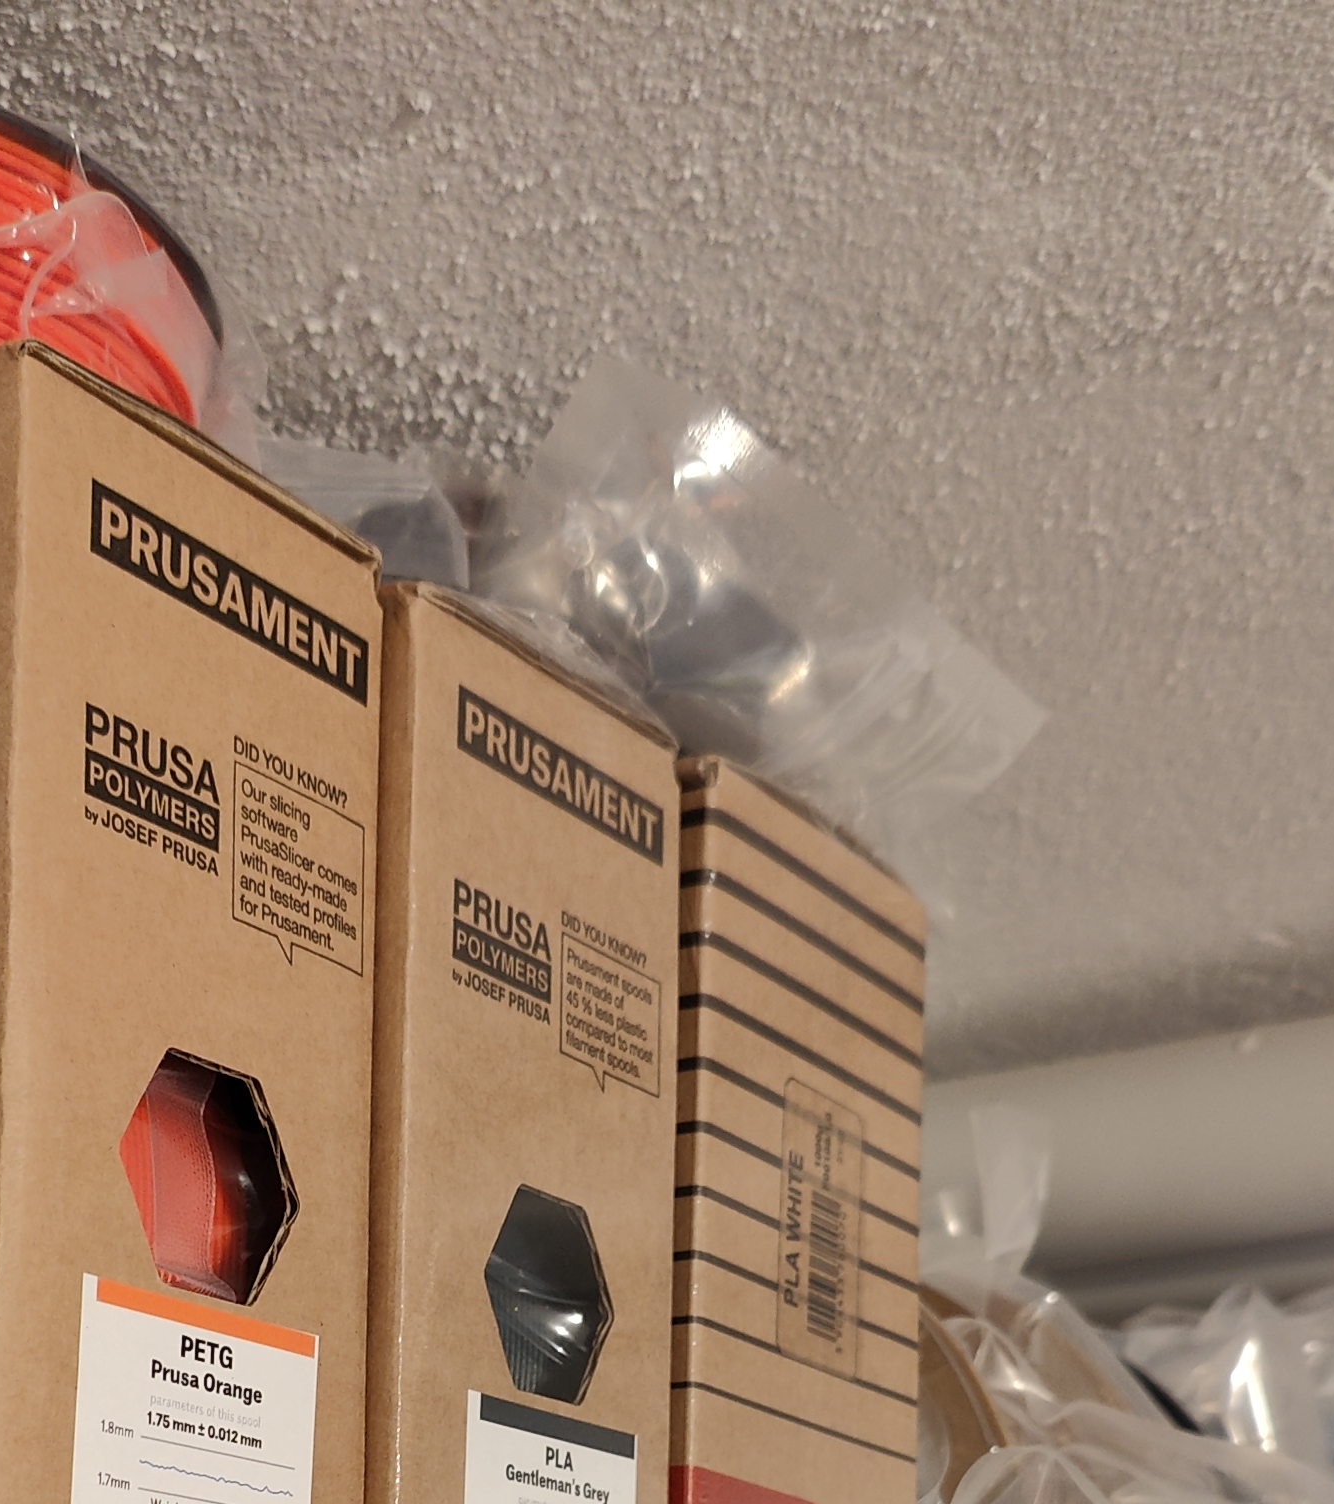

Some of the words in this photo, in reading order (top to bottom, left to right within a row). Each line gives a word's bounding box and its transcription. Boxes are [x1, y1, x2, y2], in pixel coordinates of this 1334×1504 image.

[101, 497, 362, 688] PRUSAMENT
[86, 702, 220, 805] PRUSA
[233, 734, 259, 763] DID
[262, 748, 293, 781] YOU
[297, 767, 347, 809] KNOW?
[465, 701, 657, 851] PRUSAMENT
[90, 760, 215, 841] POLYMERS
[240, 804, 298, 843] software
[241, 778, 267, 804] Our
[269, 794, 310, 831] slicing
[84, 805, 98, 825] by
[100, 810, 158, 847] JOSEF
[162, 834, 219, 876] PRUSA
[241, 825, 315, 873] PrusaSlicer
[317, 864, 357, 896] comes
[239, 850, 268, 883] with
[270, 864, 347, 914] ready-made
[239, 874, 267, 907] and
[266, 884, 309, 917] tested
[313, 906, 356, 940] profiles
[239, 893, 259, 917] for
[261, 902, 334, 951] Prusament.
[455, 878, 551, 962] PRUSA
[456, 927, 548, 993] POLYMERS
[451, 968, 463, 985] by
[463, 970, 506, 1002] JOSEF
[508, 990, 550, 1025] PRUSA
[787, 1150, 804, 1242] WHITE
[784, 1252, 800, 1308] PLA
[151, 1358, 199, 1389] Prusa
[203, 1372, 262, 1406] Orange
[180, 1335, 233, 1369] PETG
[101, 1420, 134, 1438] 1.8mm
[147, 1410, 170, 1428] 1.75
[172, 1419, 195, 1434] mm
[207, 1424, 238, 1443] 0.012
[240, 1434, 262, 1449] mm
[546, 1447, 573, 1471] PLA
[98, 1472, 130, 1490] 1.7mm
[505, 1463, 580, 1496] Gentleman's
